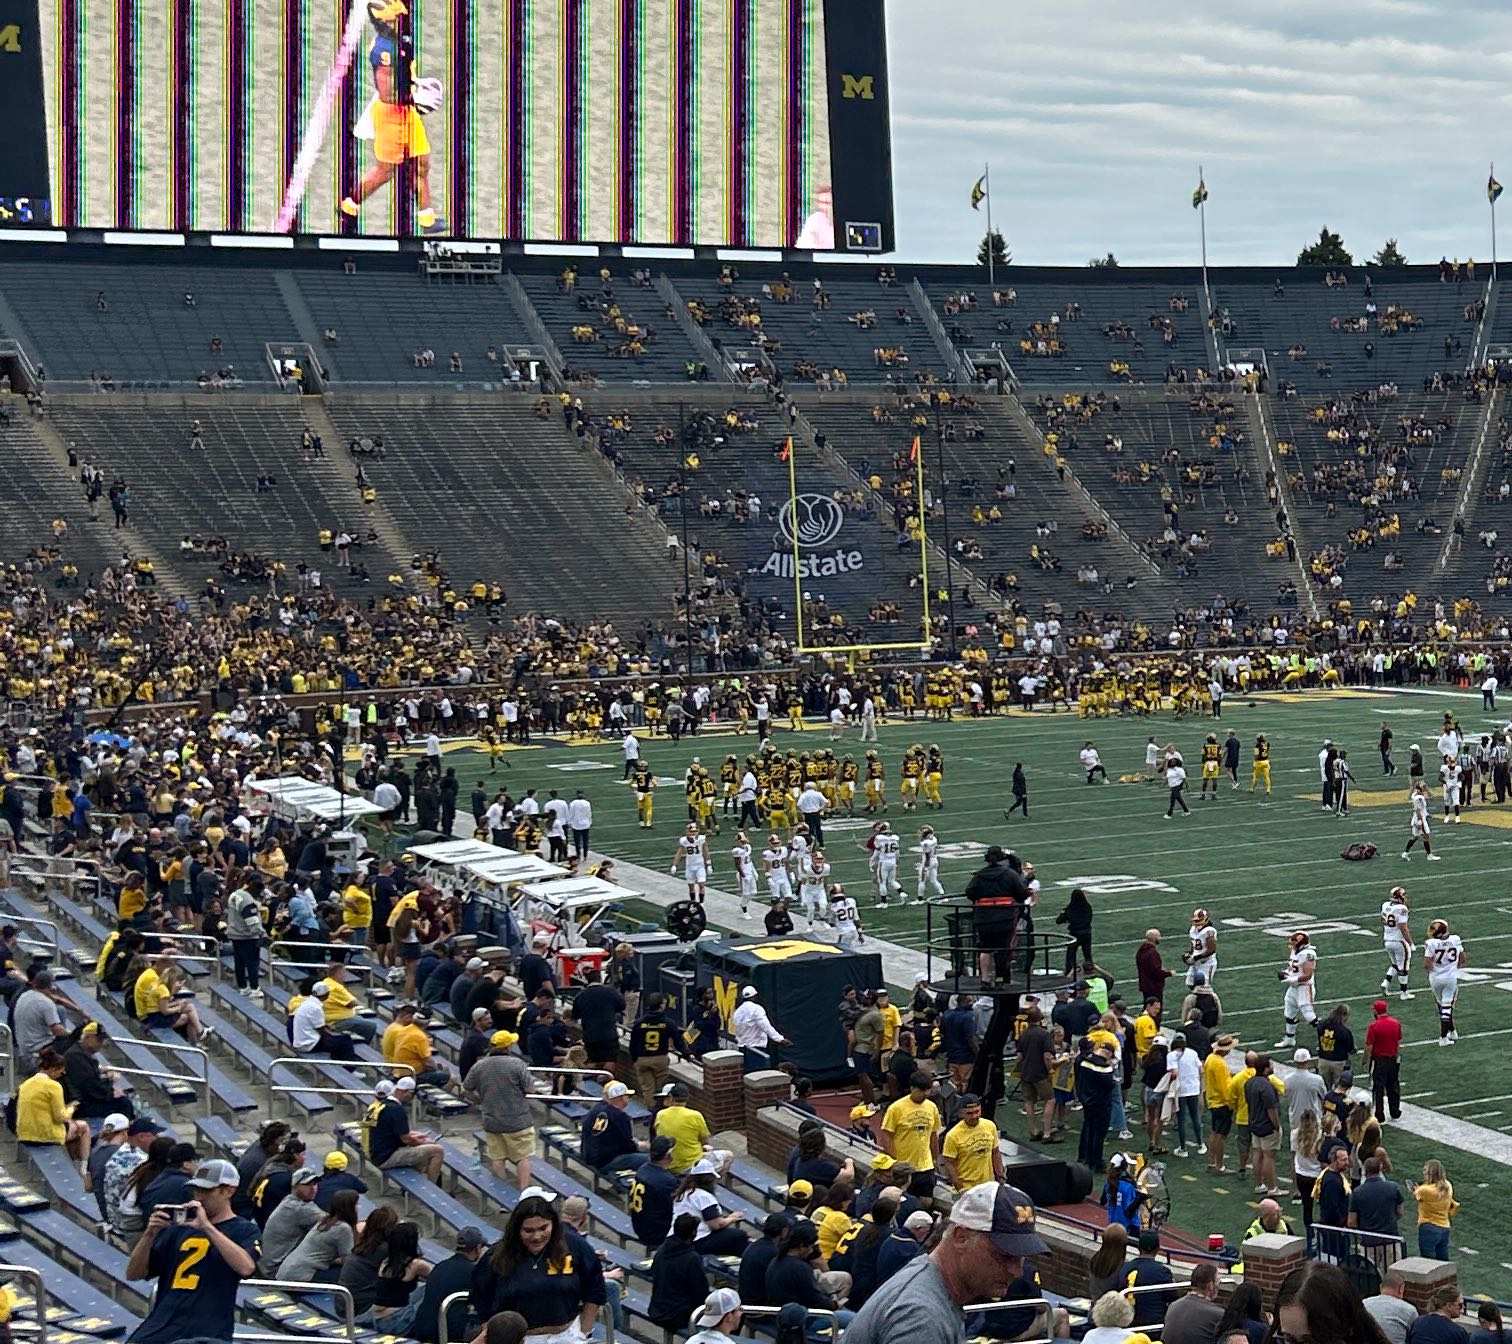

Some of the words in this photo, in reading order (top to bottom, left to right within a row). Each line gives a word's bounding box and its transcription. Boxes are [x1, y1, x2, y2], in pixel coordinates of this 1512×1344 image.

[842, 74, 874, 100] M
[761, 549, 864, 578] Allstate
[687, 846, 700, 855] 81
[884, 843, 897, 854] 16
[837, 908, 855, 921] 20
[1434, 948, 1458, 964] 73
[713, 975, 738, 1036] M
[645, 1031, 660, 1051] 9
[1015, 1206, 1035, 1224] M
[171, 1237, 211, 1290] 2
